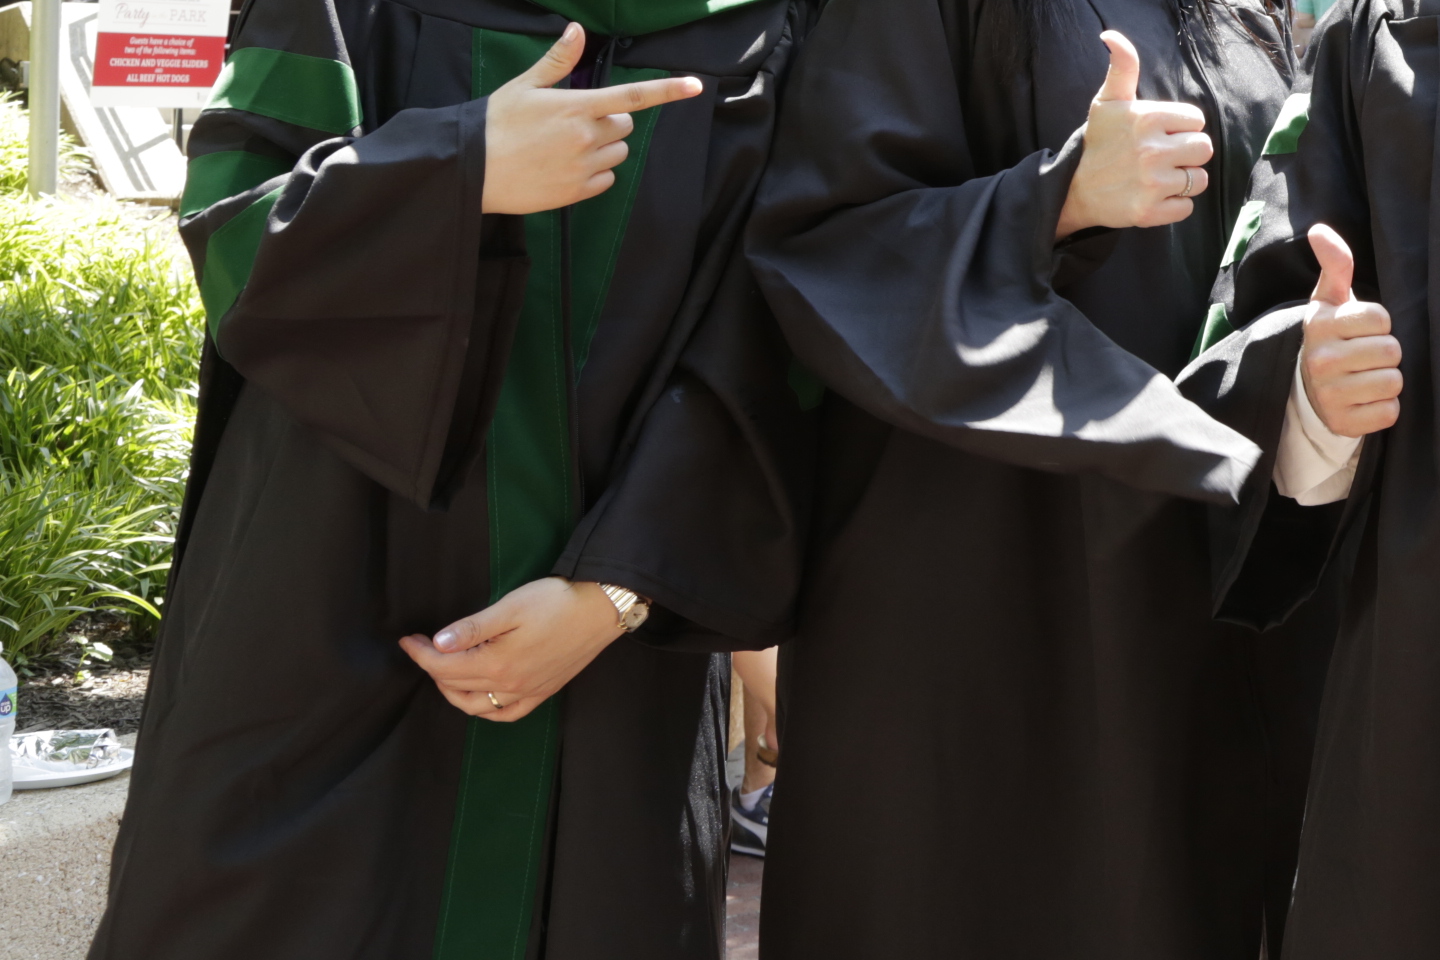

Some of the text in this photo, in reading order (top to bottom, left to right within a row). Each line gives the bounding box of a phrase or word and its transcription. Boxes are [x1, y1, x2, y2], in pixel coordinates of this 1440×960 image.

[115, 2, 207, 29] Party PARK
[129, 36, 149, 45] Guests
[149, 36, 163, 46] have
[169, 36, 187, 47] choice
[187, 37, 195, 48] of
[124, 46, 135, 54] two
[135, 45, 144, 56] of
[143, 46, 152, 54] the
[151, 46, 179, 57] following
[109, 57, 209, 69] CHICKEN AND VEGGIE SLIDERS
[126, 73, 190, 83] ALL BEEF HOT DOGS
